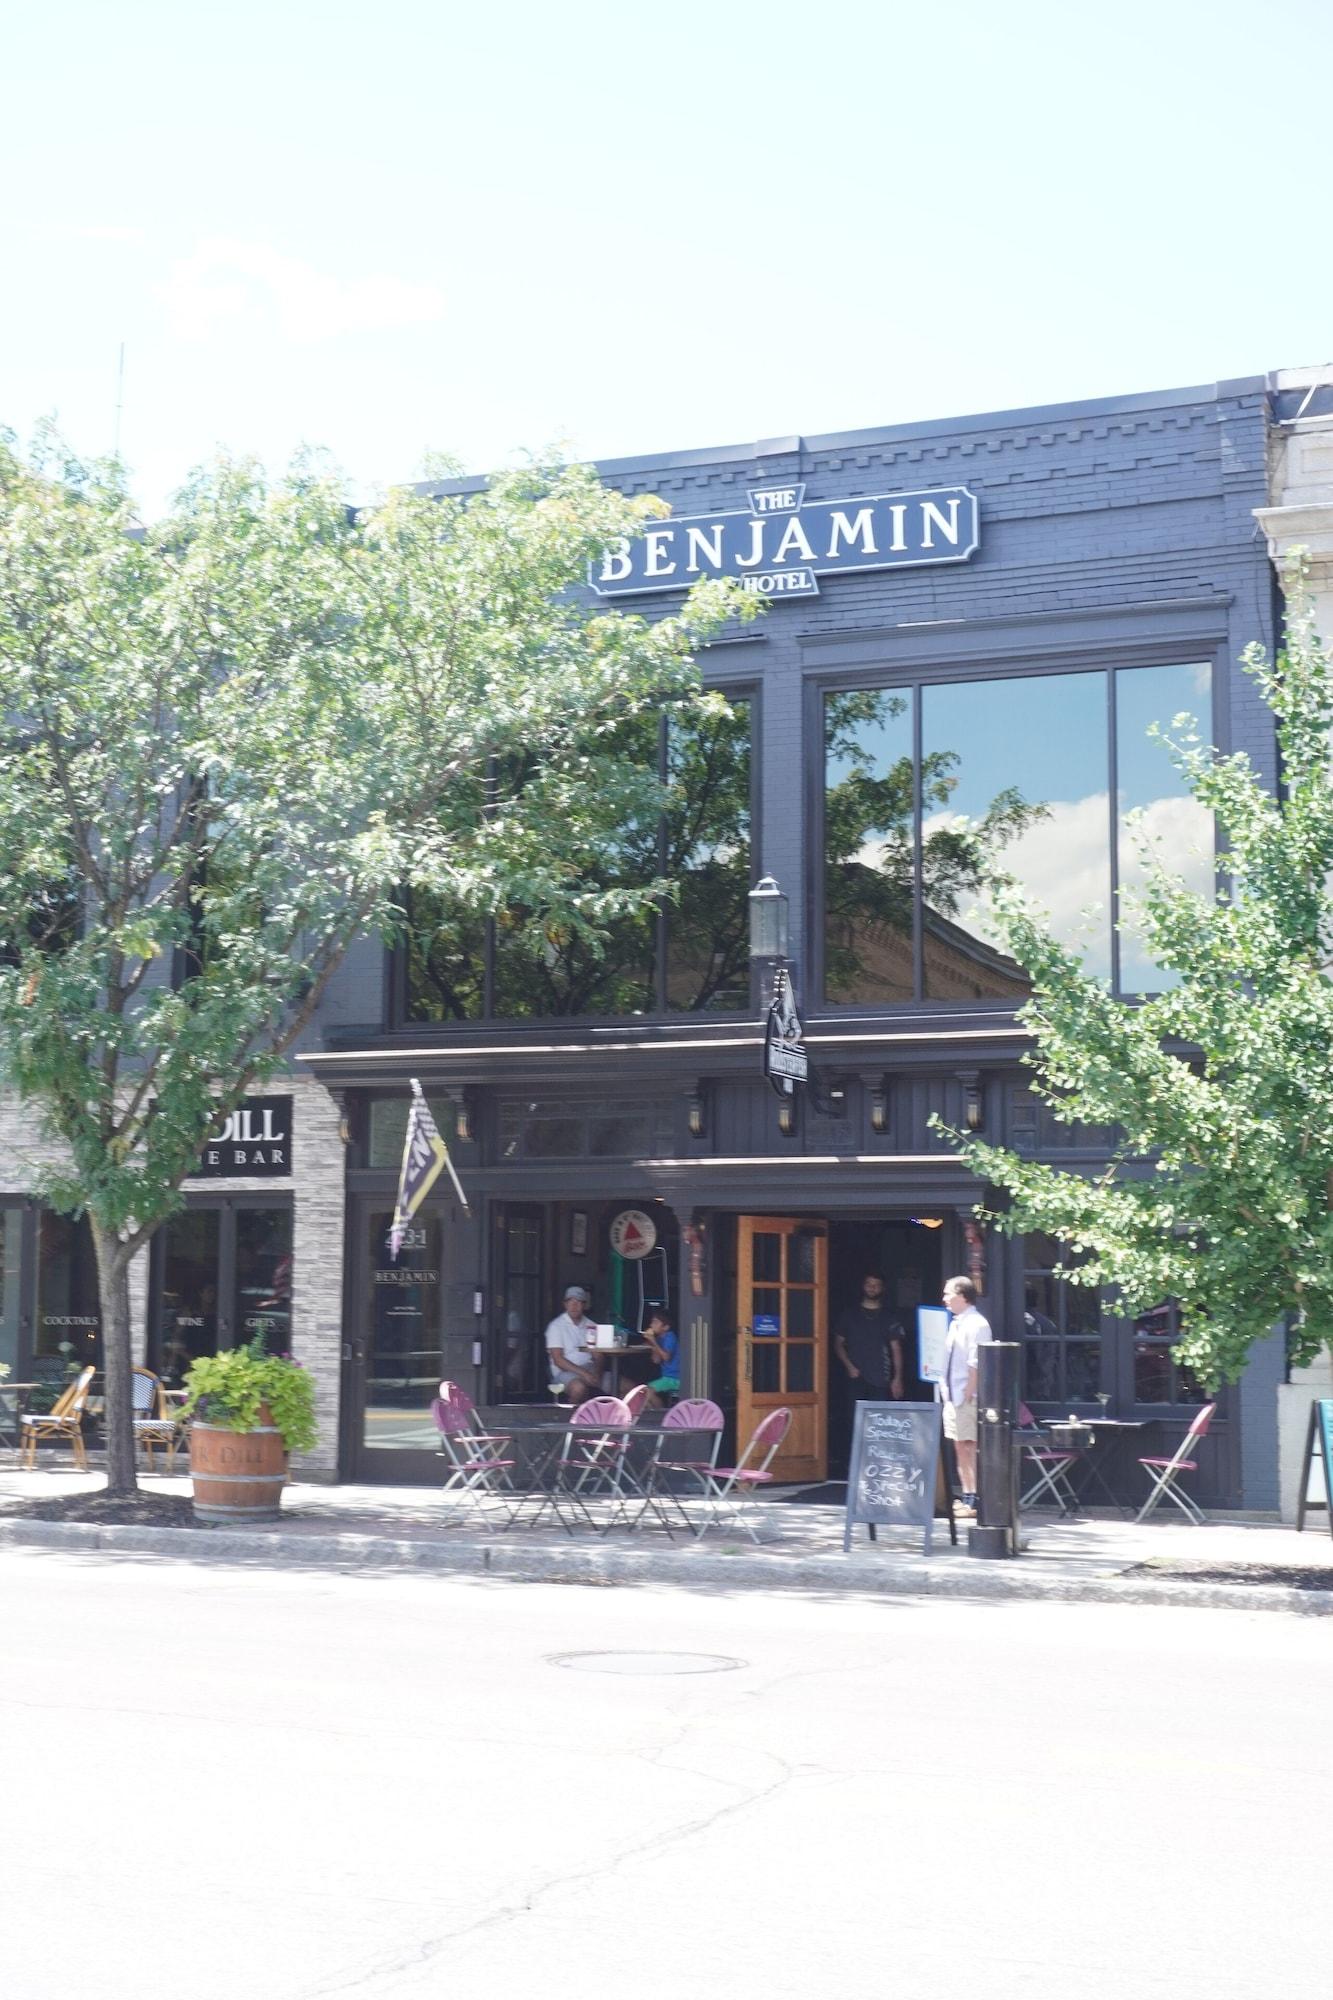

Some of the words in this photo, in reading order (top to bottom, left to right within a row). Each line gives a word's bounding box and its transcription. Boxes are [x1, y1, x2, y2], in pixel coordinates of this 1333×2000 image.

[754, 489, 797, 512] THE
[599, 499, 961, 582] BENJAMIN
[744, 571, 813, 594] HOTEL
[233, 1149, 285, 1165] BAR
[374, 1272, 436, 1282] BENJAMIN
[43, 1316, 98, 1326] COCKTAILS
[176, 1316, 205, 1326] WINE
